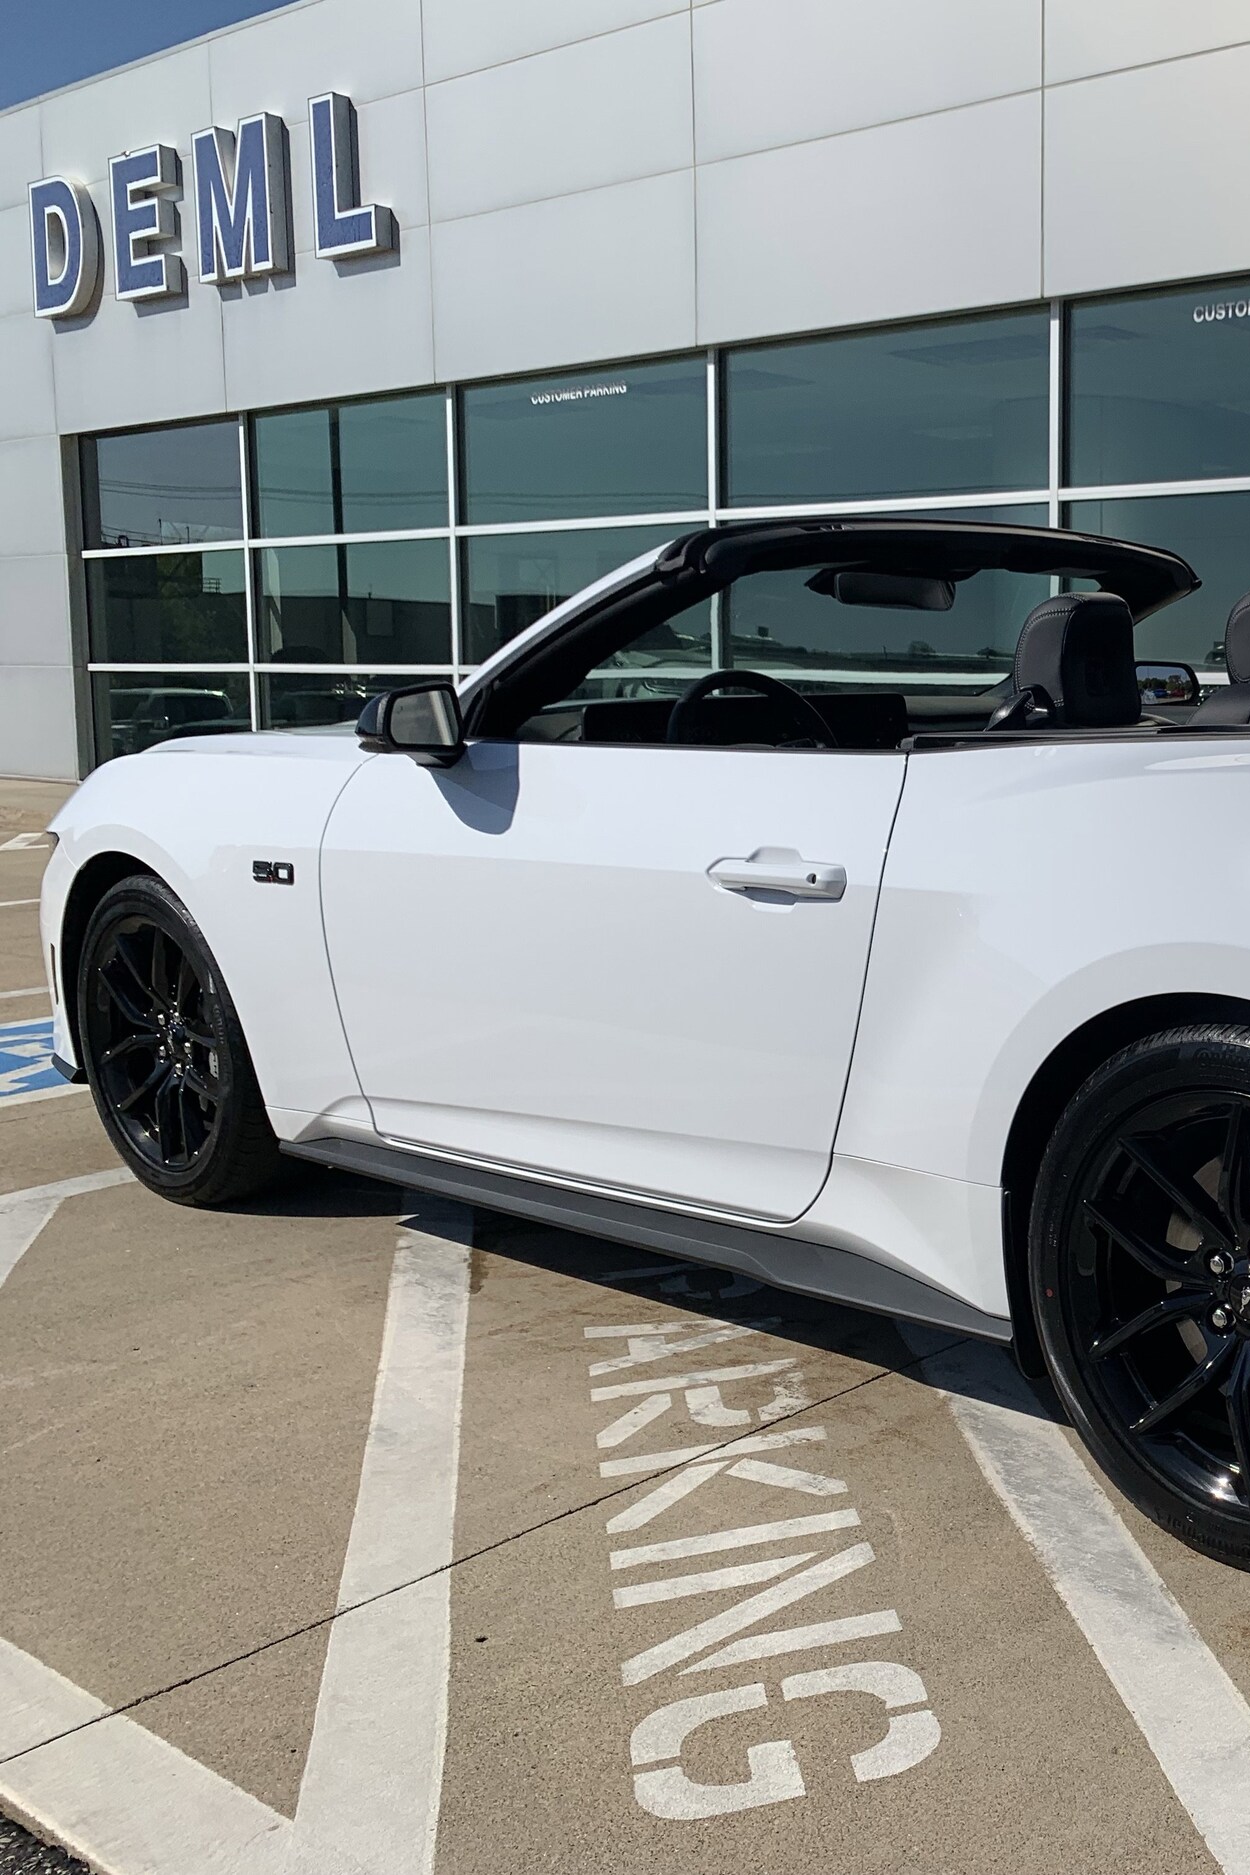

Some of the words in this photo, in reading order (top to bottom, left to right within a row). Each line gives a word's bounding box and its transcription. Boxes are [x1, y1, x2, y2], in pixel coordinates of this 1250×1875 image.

[28, 91, 396, 320] DEML
[530, 385, 583, 405] CUSTOMER
[583, 380, 627, 398] PARKING
